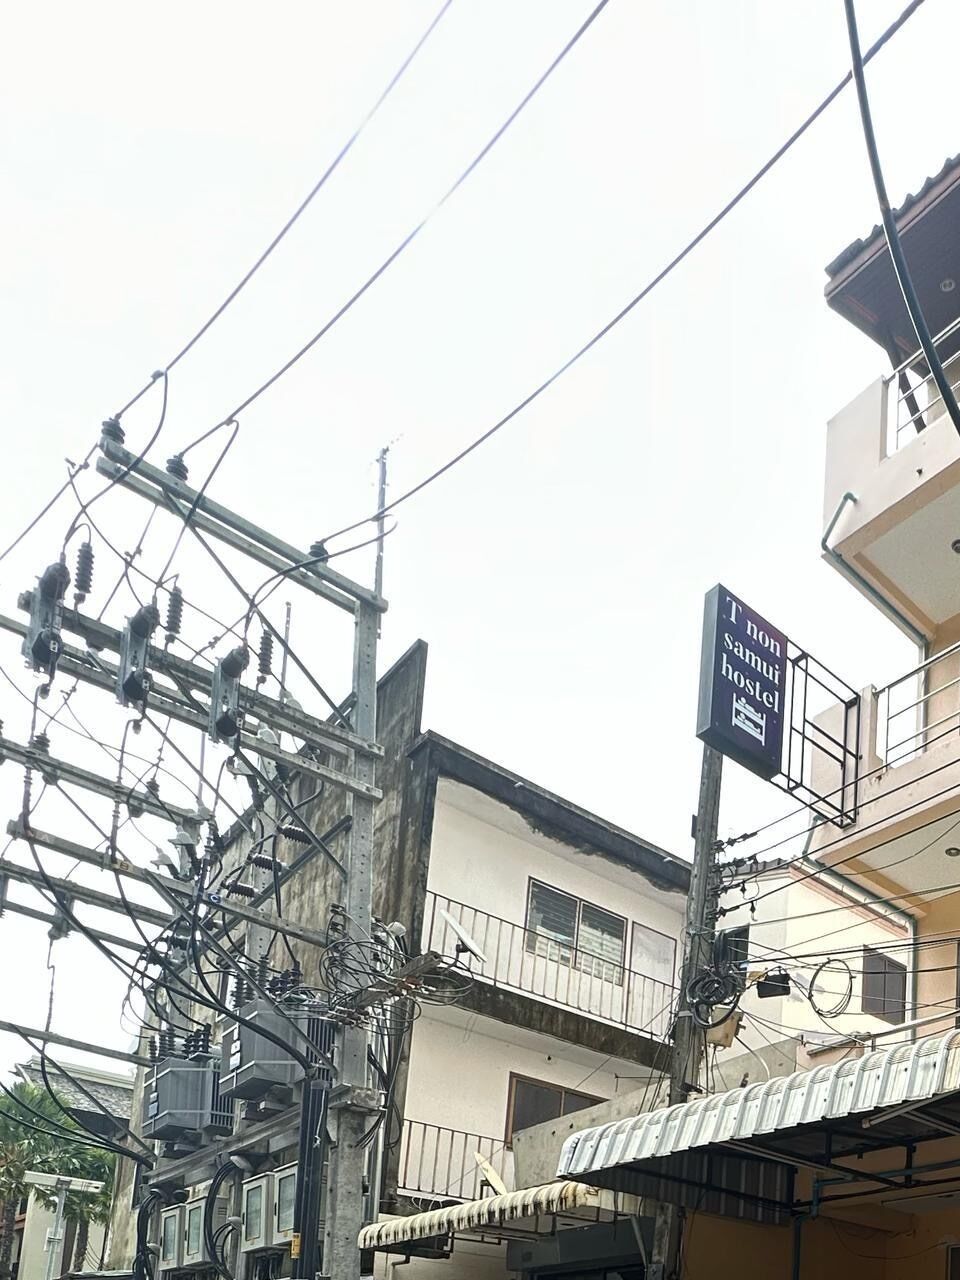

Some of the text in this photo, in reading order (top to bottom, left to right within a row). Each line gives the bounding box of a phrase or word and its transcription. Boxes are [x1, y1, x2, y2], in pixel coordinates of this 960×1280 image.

[726, 596, 781, 657] T non
[721, 652, 779, 713] hostel
[724, 632, 781, 684] samui
